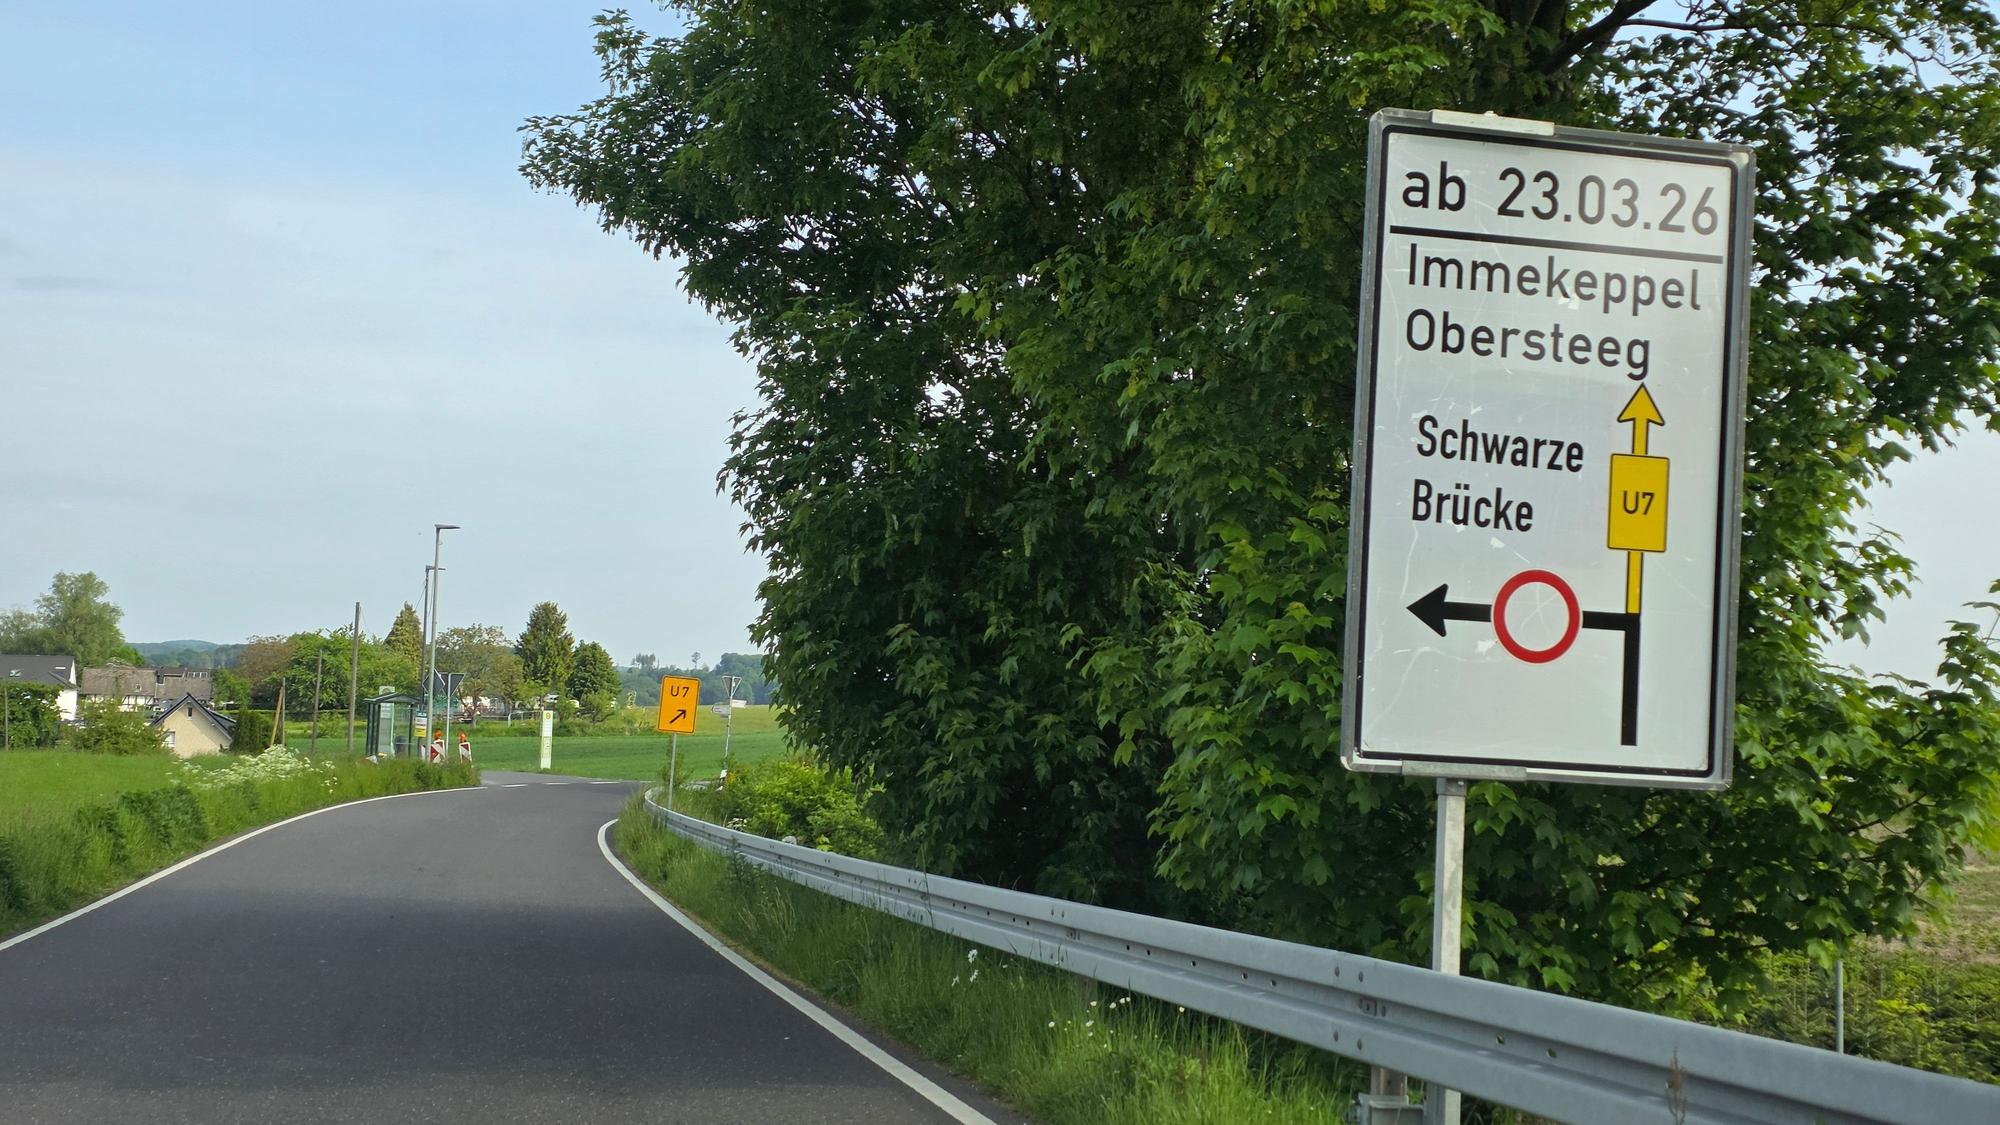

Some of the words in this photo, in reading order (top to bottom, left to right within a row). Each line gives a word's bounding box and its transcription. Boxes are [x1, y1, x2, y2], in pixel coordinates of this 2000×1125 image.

[1402, 161, 1466, 212] ab
[1497, 167, 1719, 236] 23.03.26
[1408, 243, 1701, 316] Immekeppel
[1406, 308, 1650, 381] Obersteeg
[1416, 415, 1584, 472] Schwarze
[1412, 479, 1534, 532] Brücke
[1623, 491, 1655, 515] U7
[670, 685, 690, 698] U7
